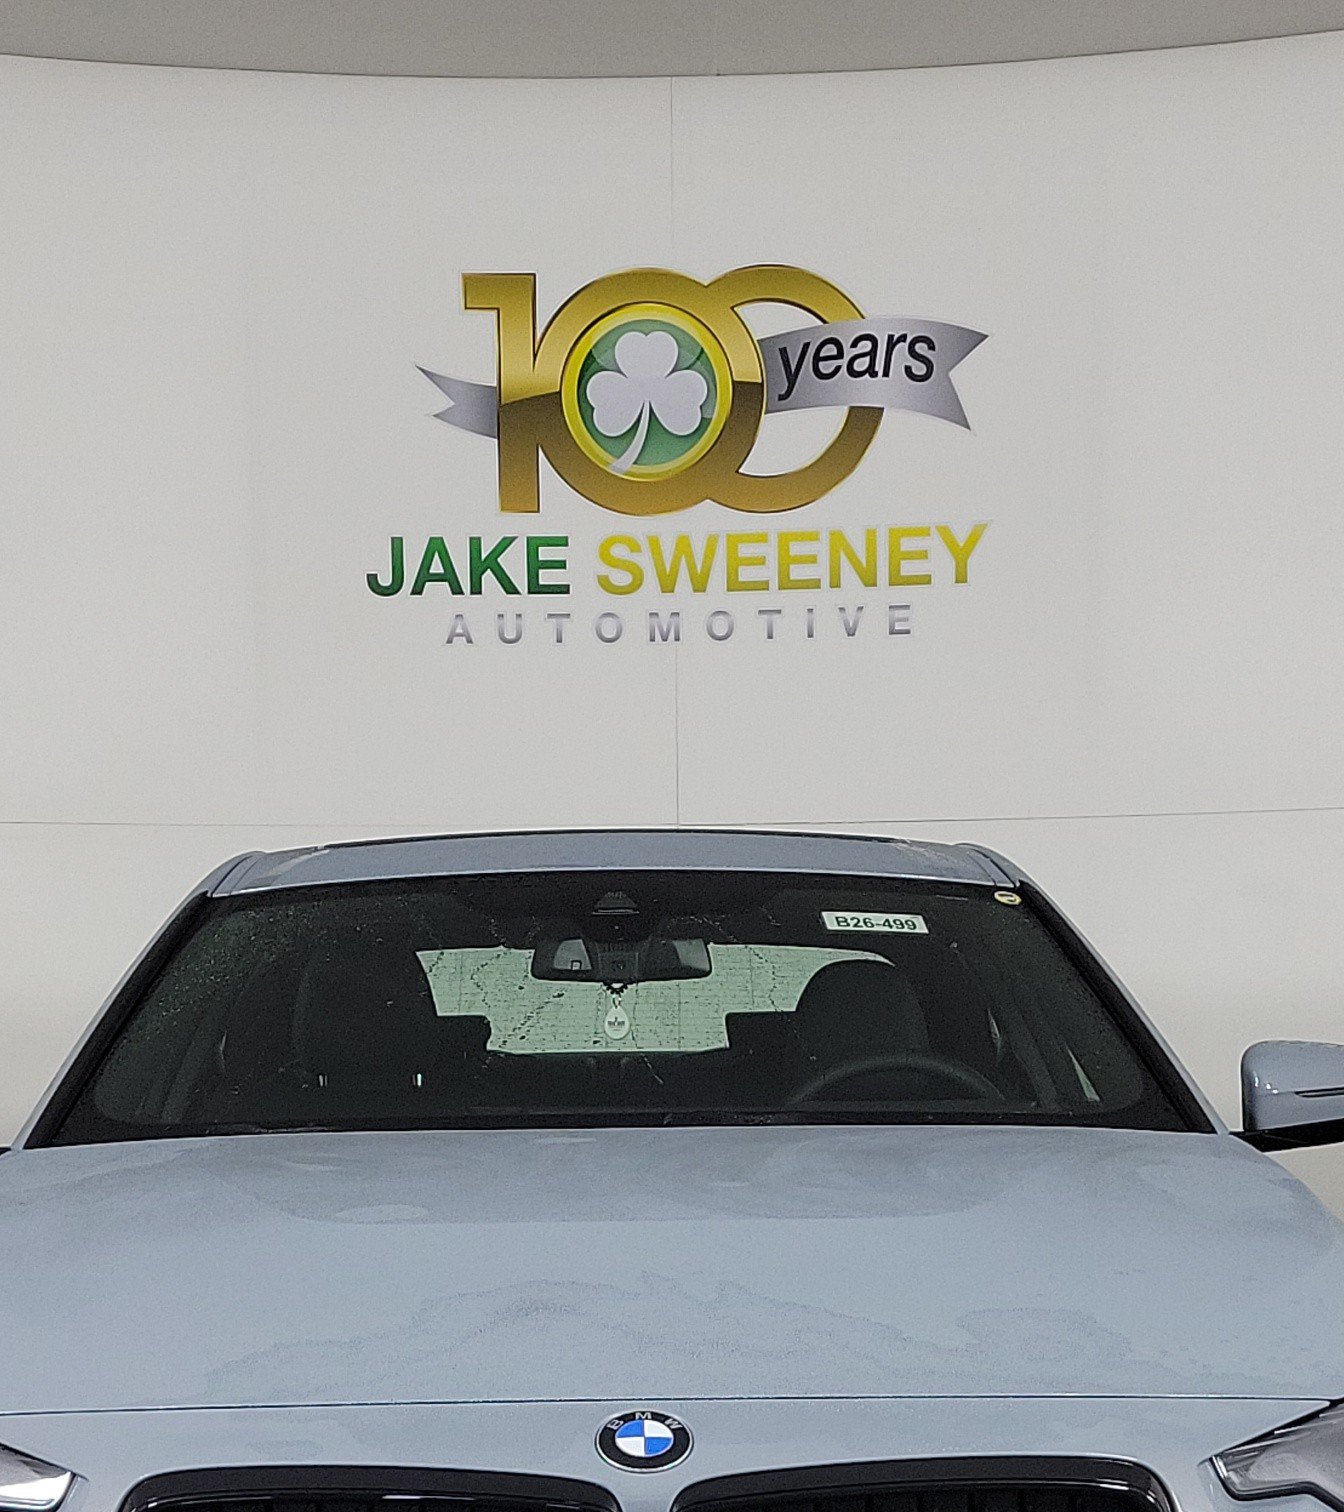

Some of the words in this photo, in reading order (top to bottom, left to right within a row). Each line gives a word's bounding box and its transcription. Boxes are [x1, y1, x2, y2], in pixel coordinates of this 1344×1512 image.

[776, 331, 936, 400] years
[366, 536, 570, 597] JAKE
[596, 522, 988, 595] SWEENEY
[445, 604, 912, 645] AUTOMOTIVE
[835, 916, 917, 930] B26-499
[606, 1411, 684, 1430] BMW
